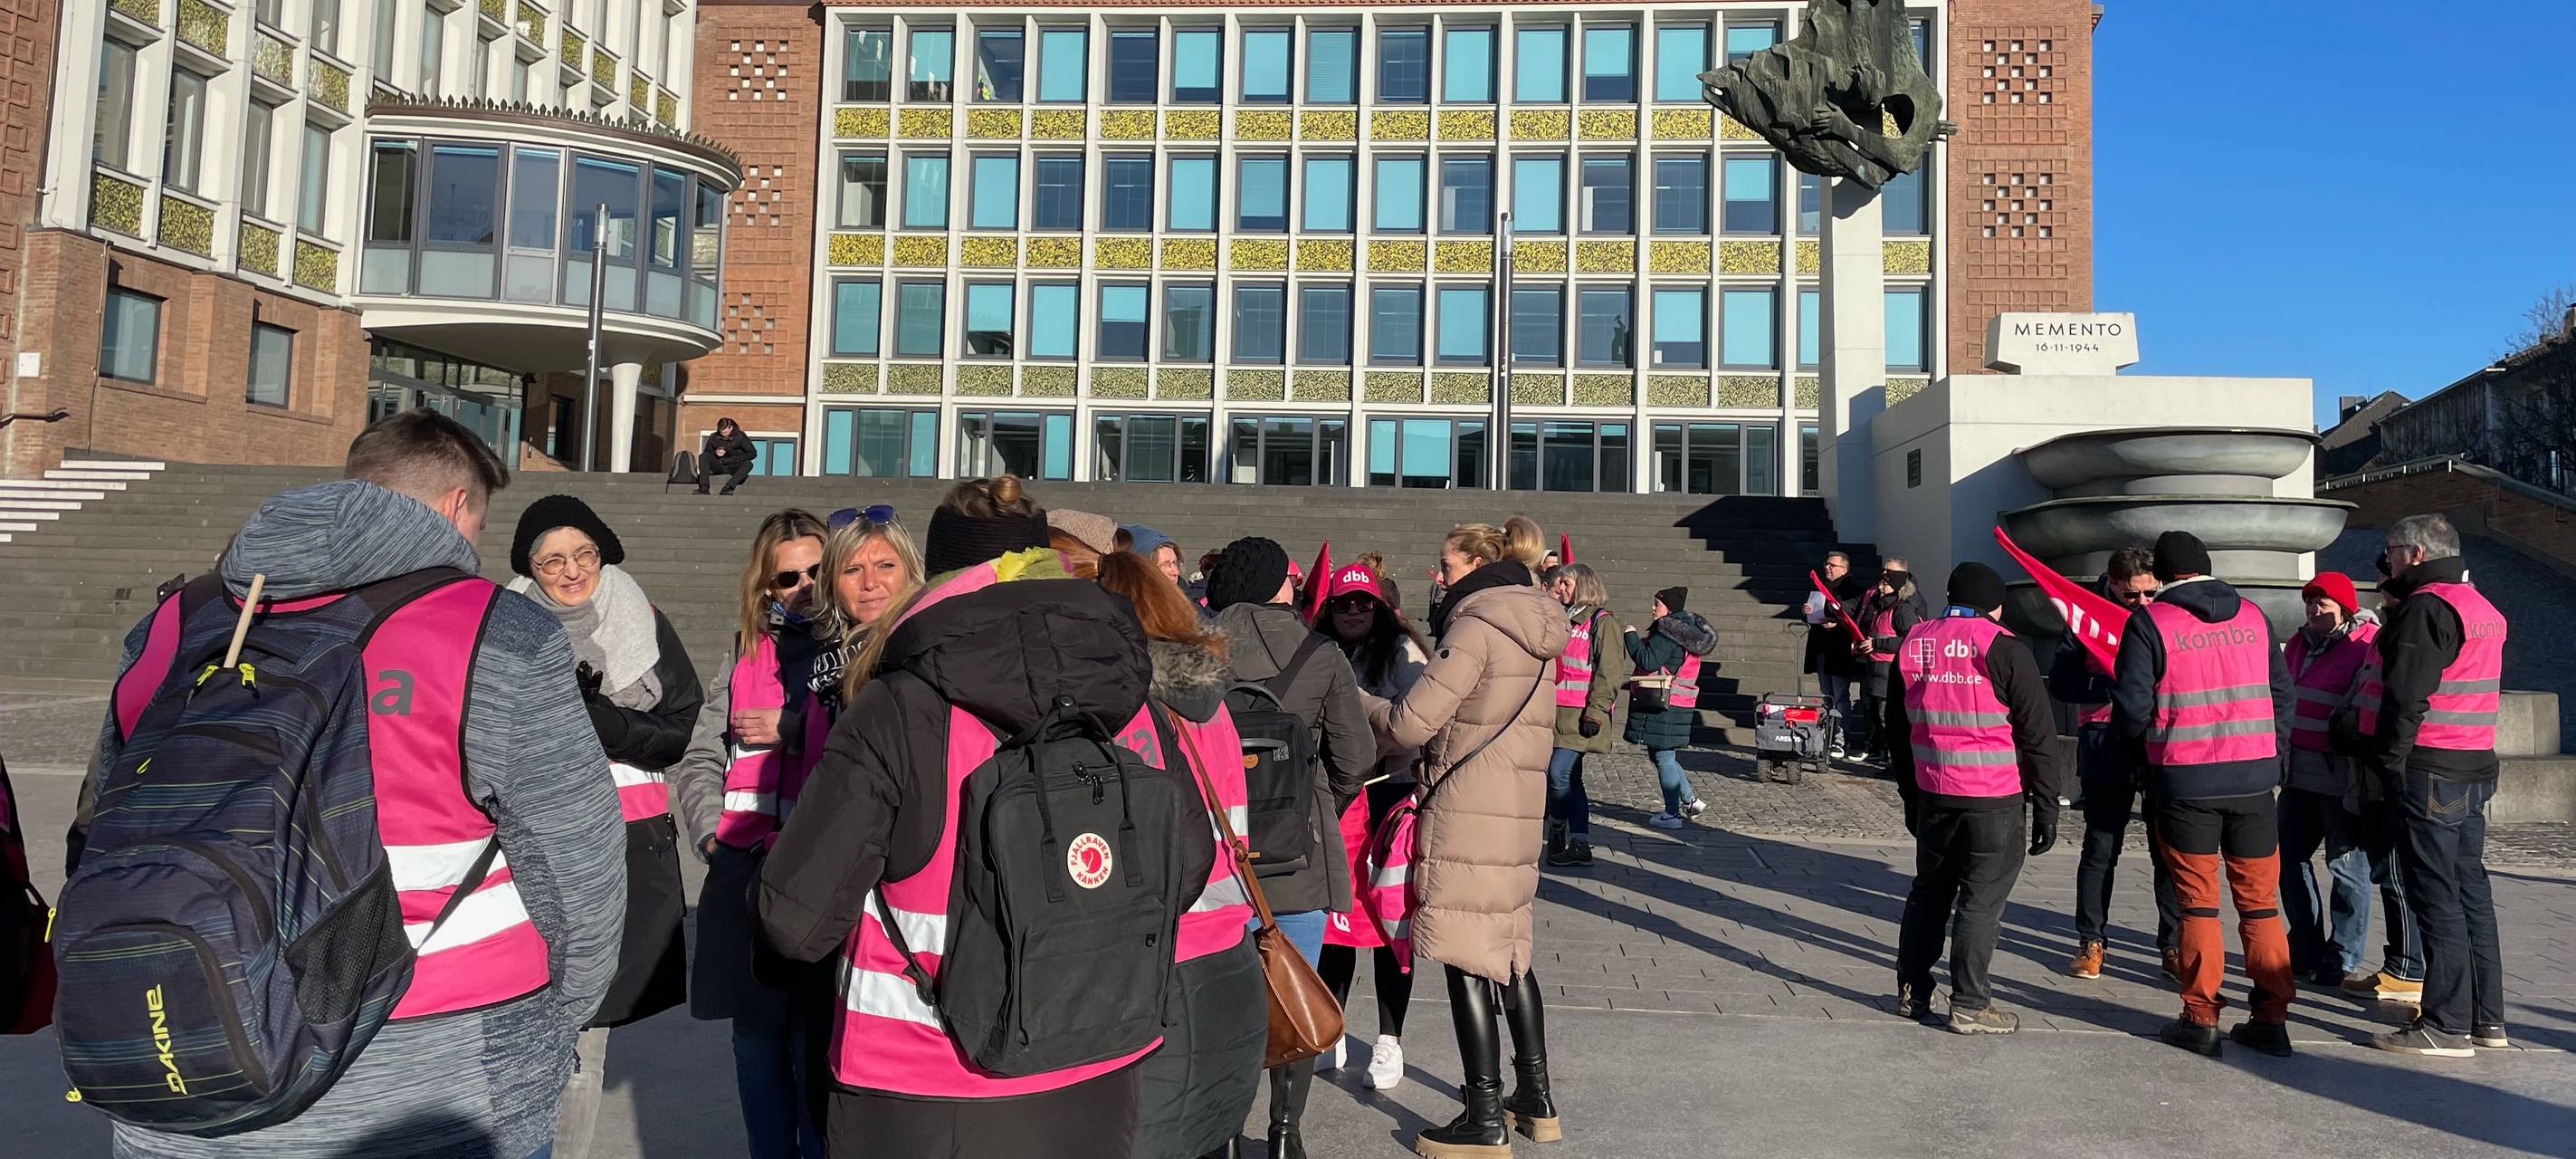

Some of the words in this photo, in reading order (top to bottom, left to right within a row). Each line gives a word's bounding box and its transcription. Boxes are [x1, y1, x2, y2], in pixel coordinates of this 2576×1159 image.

[2015, 322, 2122, 336] MEMENTO
[1342, 570, 1369, 584] dbb
[2174, 623, 2259, 652] komba
[146, 983, 188, 1096] DAKINE
